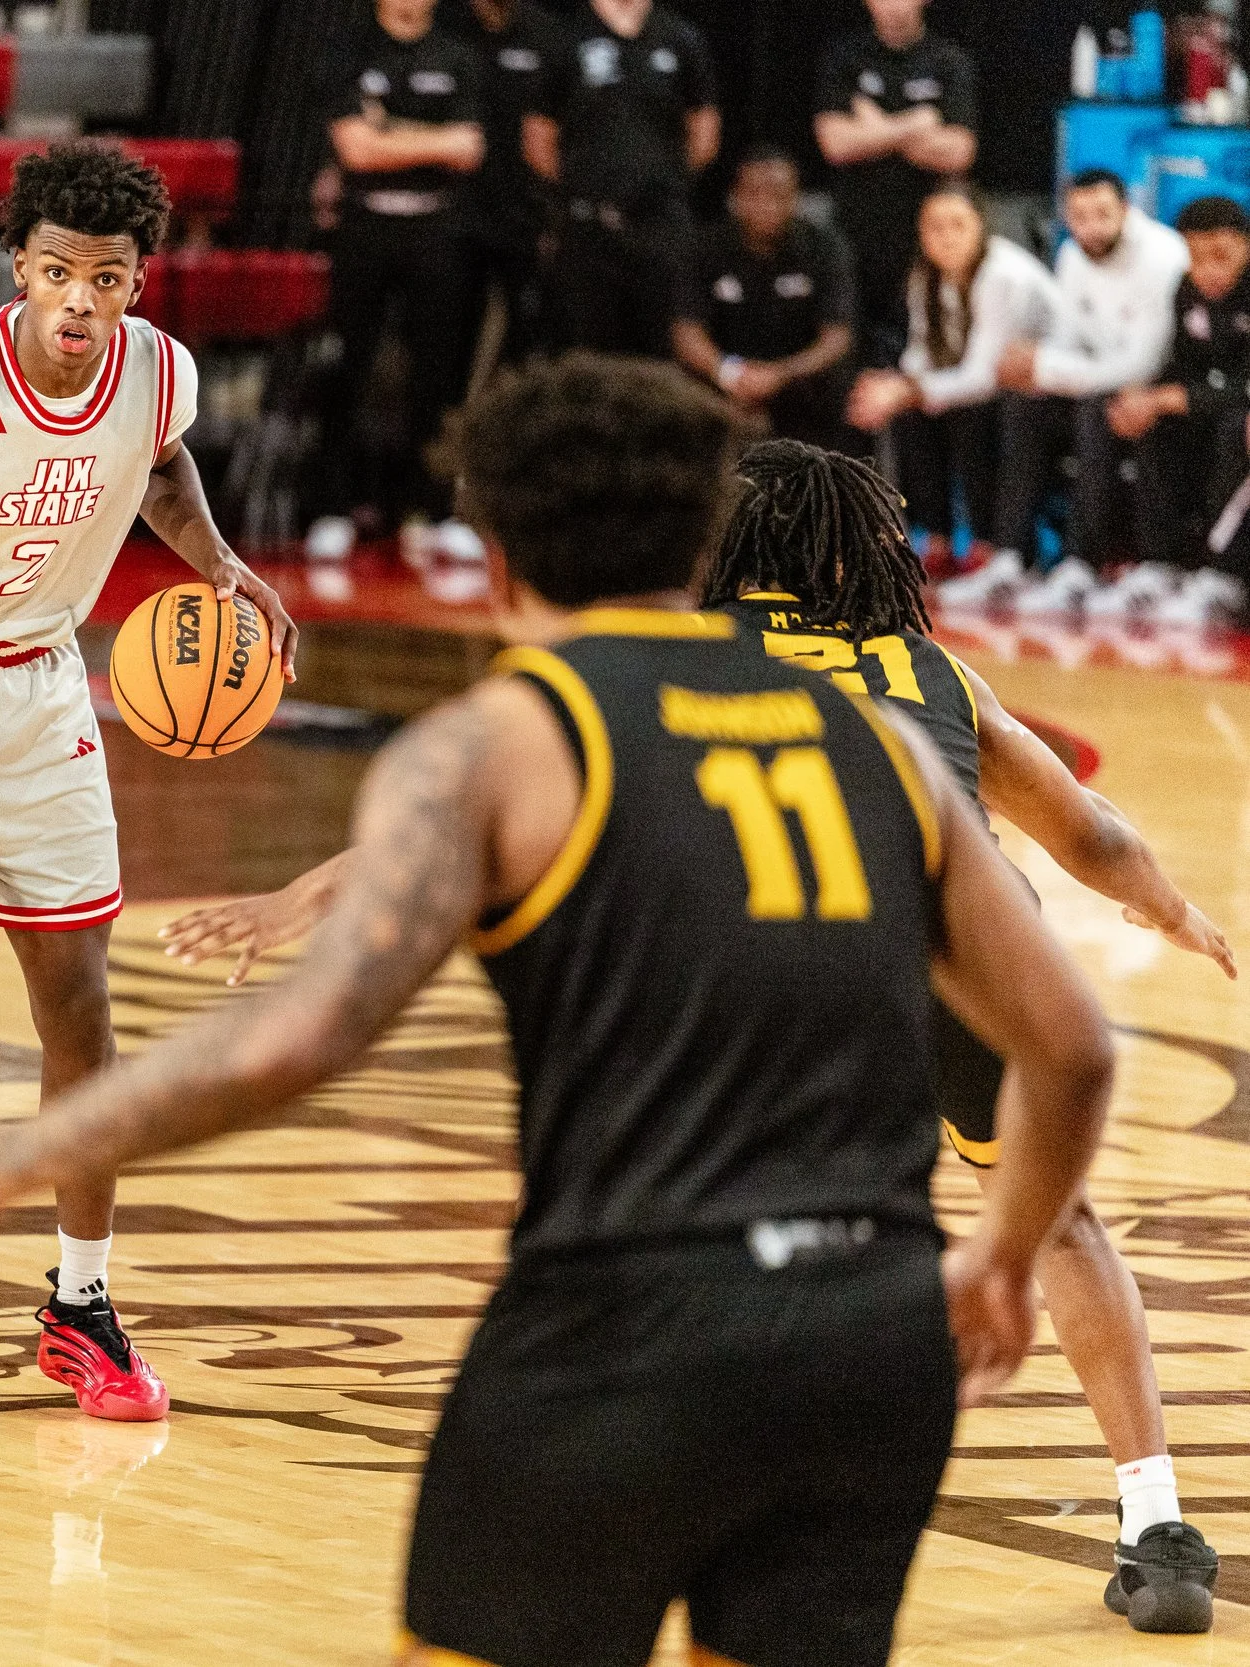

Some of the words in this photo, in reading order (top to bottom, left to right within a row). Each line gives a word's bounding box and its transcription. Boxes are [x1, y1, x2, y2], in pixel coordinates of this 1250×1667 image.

[23, 456, 97, 494] JAX
[175, 594, 203, 666] NCAA
[761, 630, 925, 706] 21
[696, 746, 873, 922] 11
